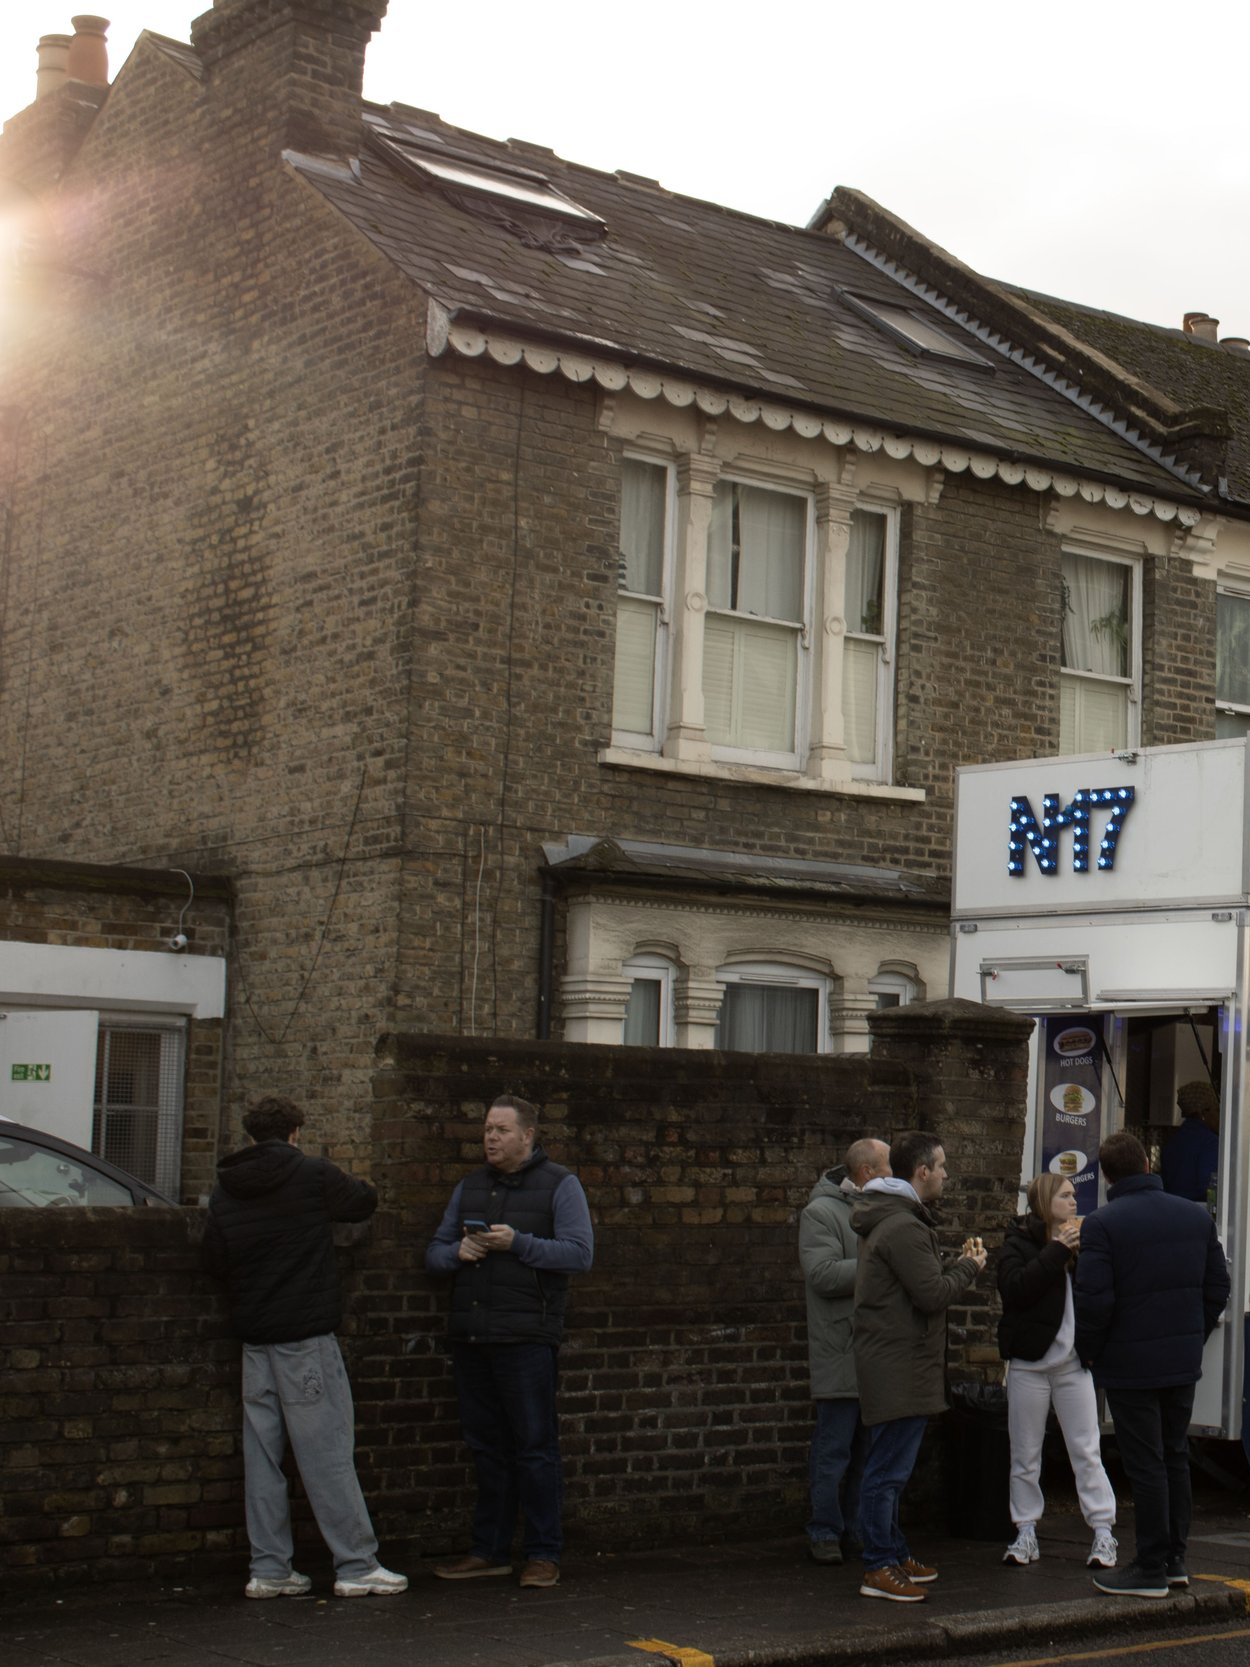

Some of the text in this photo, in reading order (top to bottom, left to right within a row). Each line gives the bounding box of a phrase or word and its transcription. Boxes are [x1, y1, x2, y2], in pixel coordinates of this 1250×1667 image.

[1007, 785, 1135, 877] N17
[1060, 1056, 1093, 1067] HOT DOGS
[1055, 1113, 1087, 1127] BURGERS
